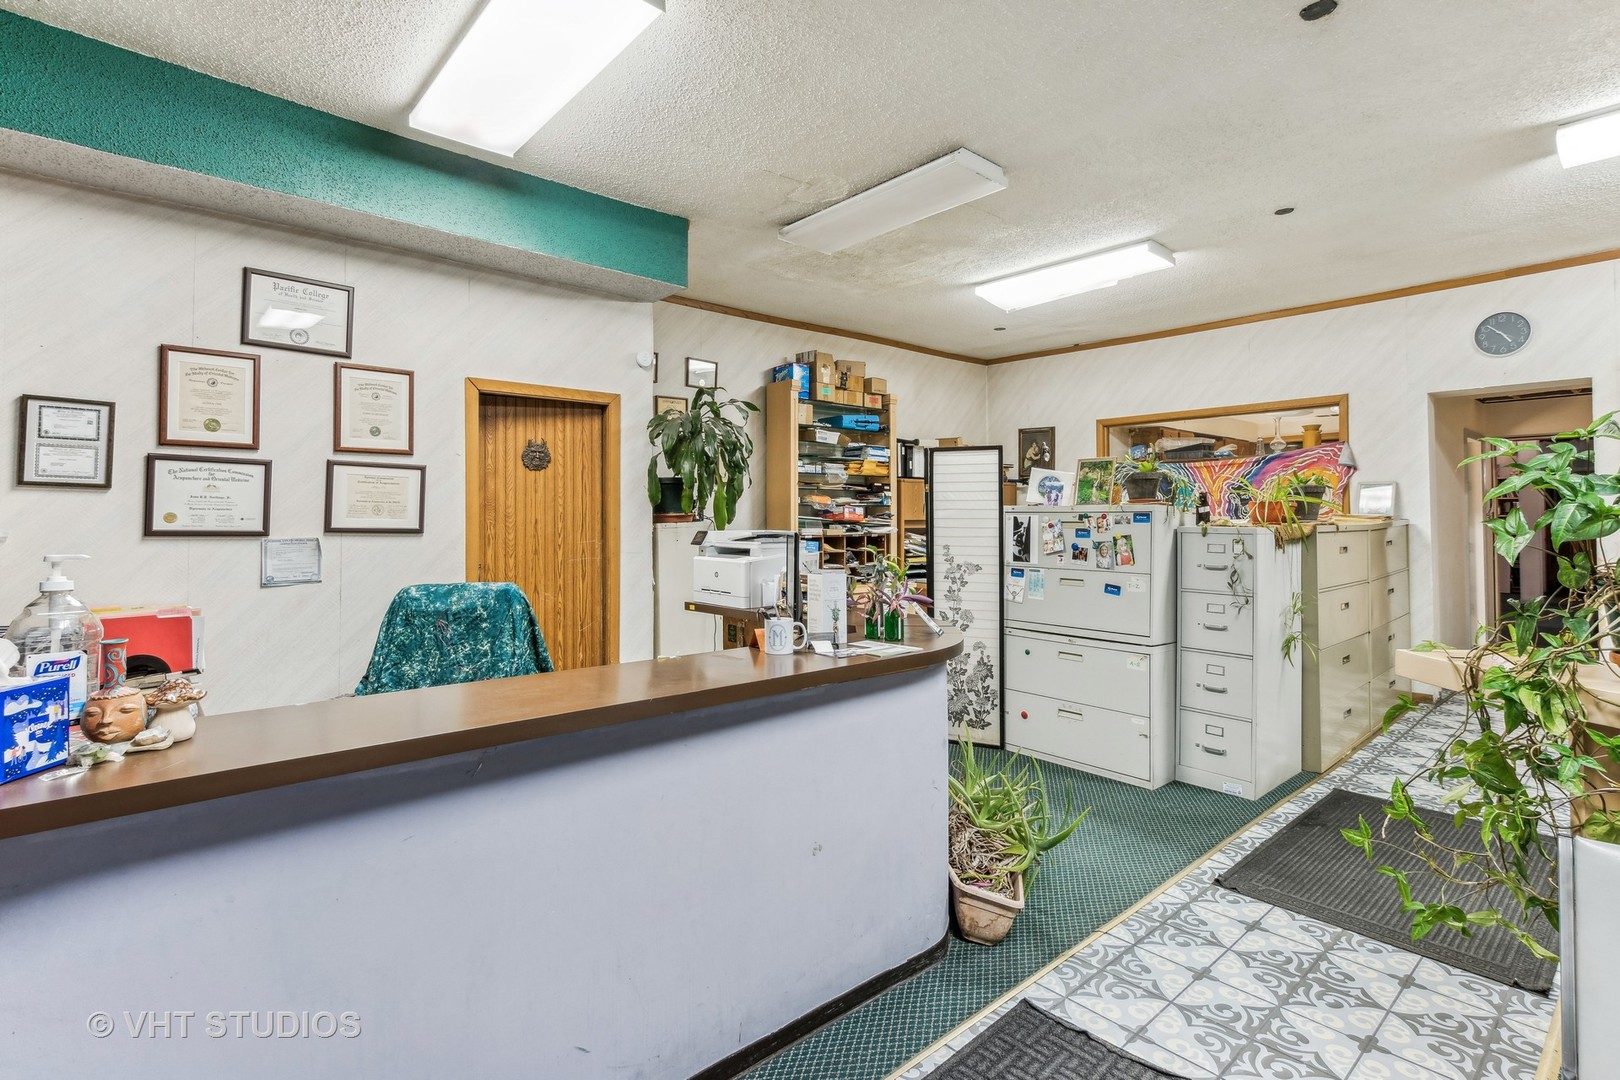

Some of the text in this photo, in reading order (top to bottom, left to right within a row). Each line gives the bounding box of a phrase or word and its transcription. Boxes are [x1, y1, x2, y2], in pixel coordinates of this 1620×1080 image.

[272, 281, 329, 300] Pacific College
[772, 629, 784, 647] M
[39, 659, 78, 673] Purell
